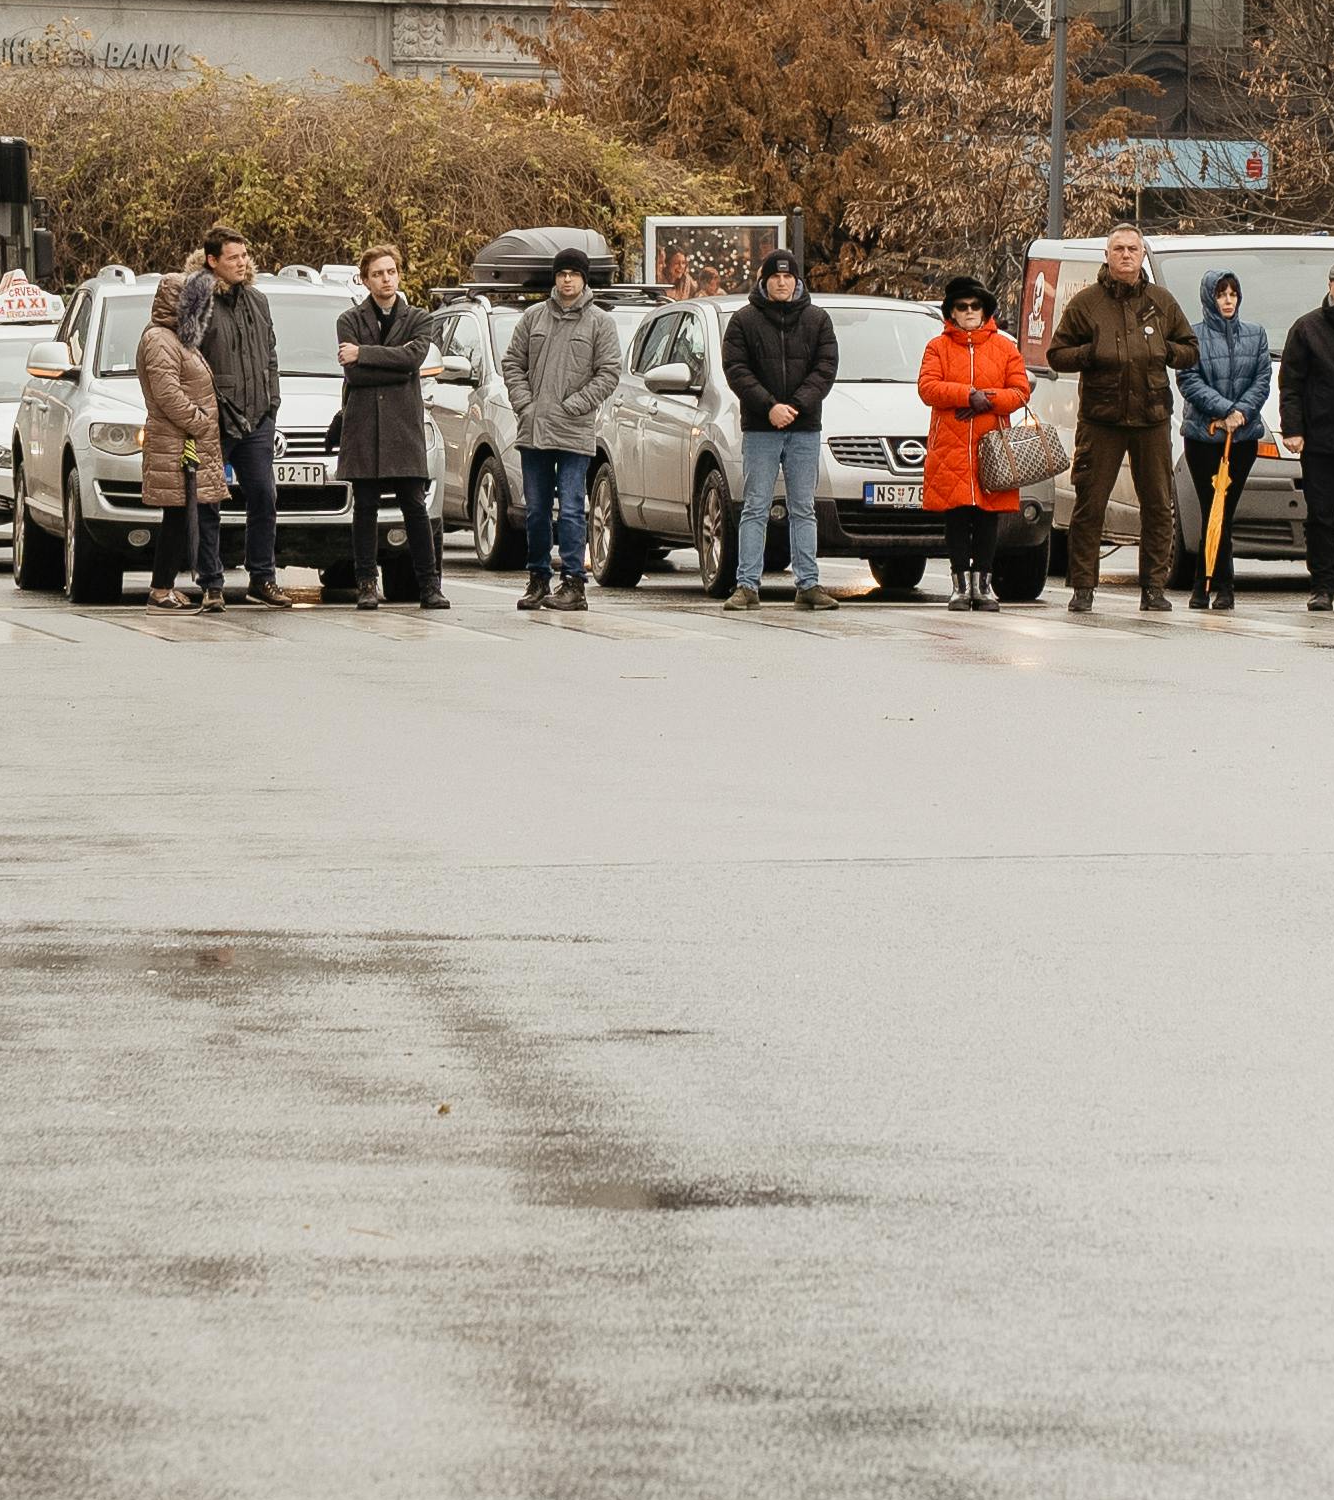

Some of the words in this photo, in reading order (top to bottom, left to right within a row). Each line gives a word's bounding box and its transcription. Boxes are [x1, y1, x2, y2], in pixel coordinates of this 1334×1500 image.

[105, 41, 189, 71] BANK
[5, 299, 47, 310] TAXI
[876, 486, 895, 501] NS
